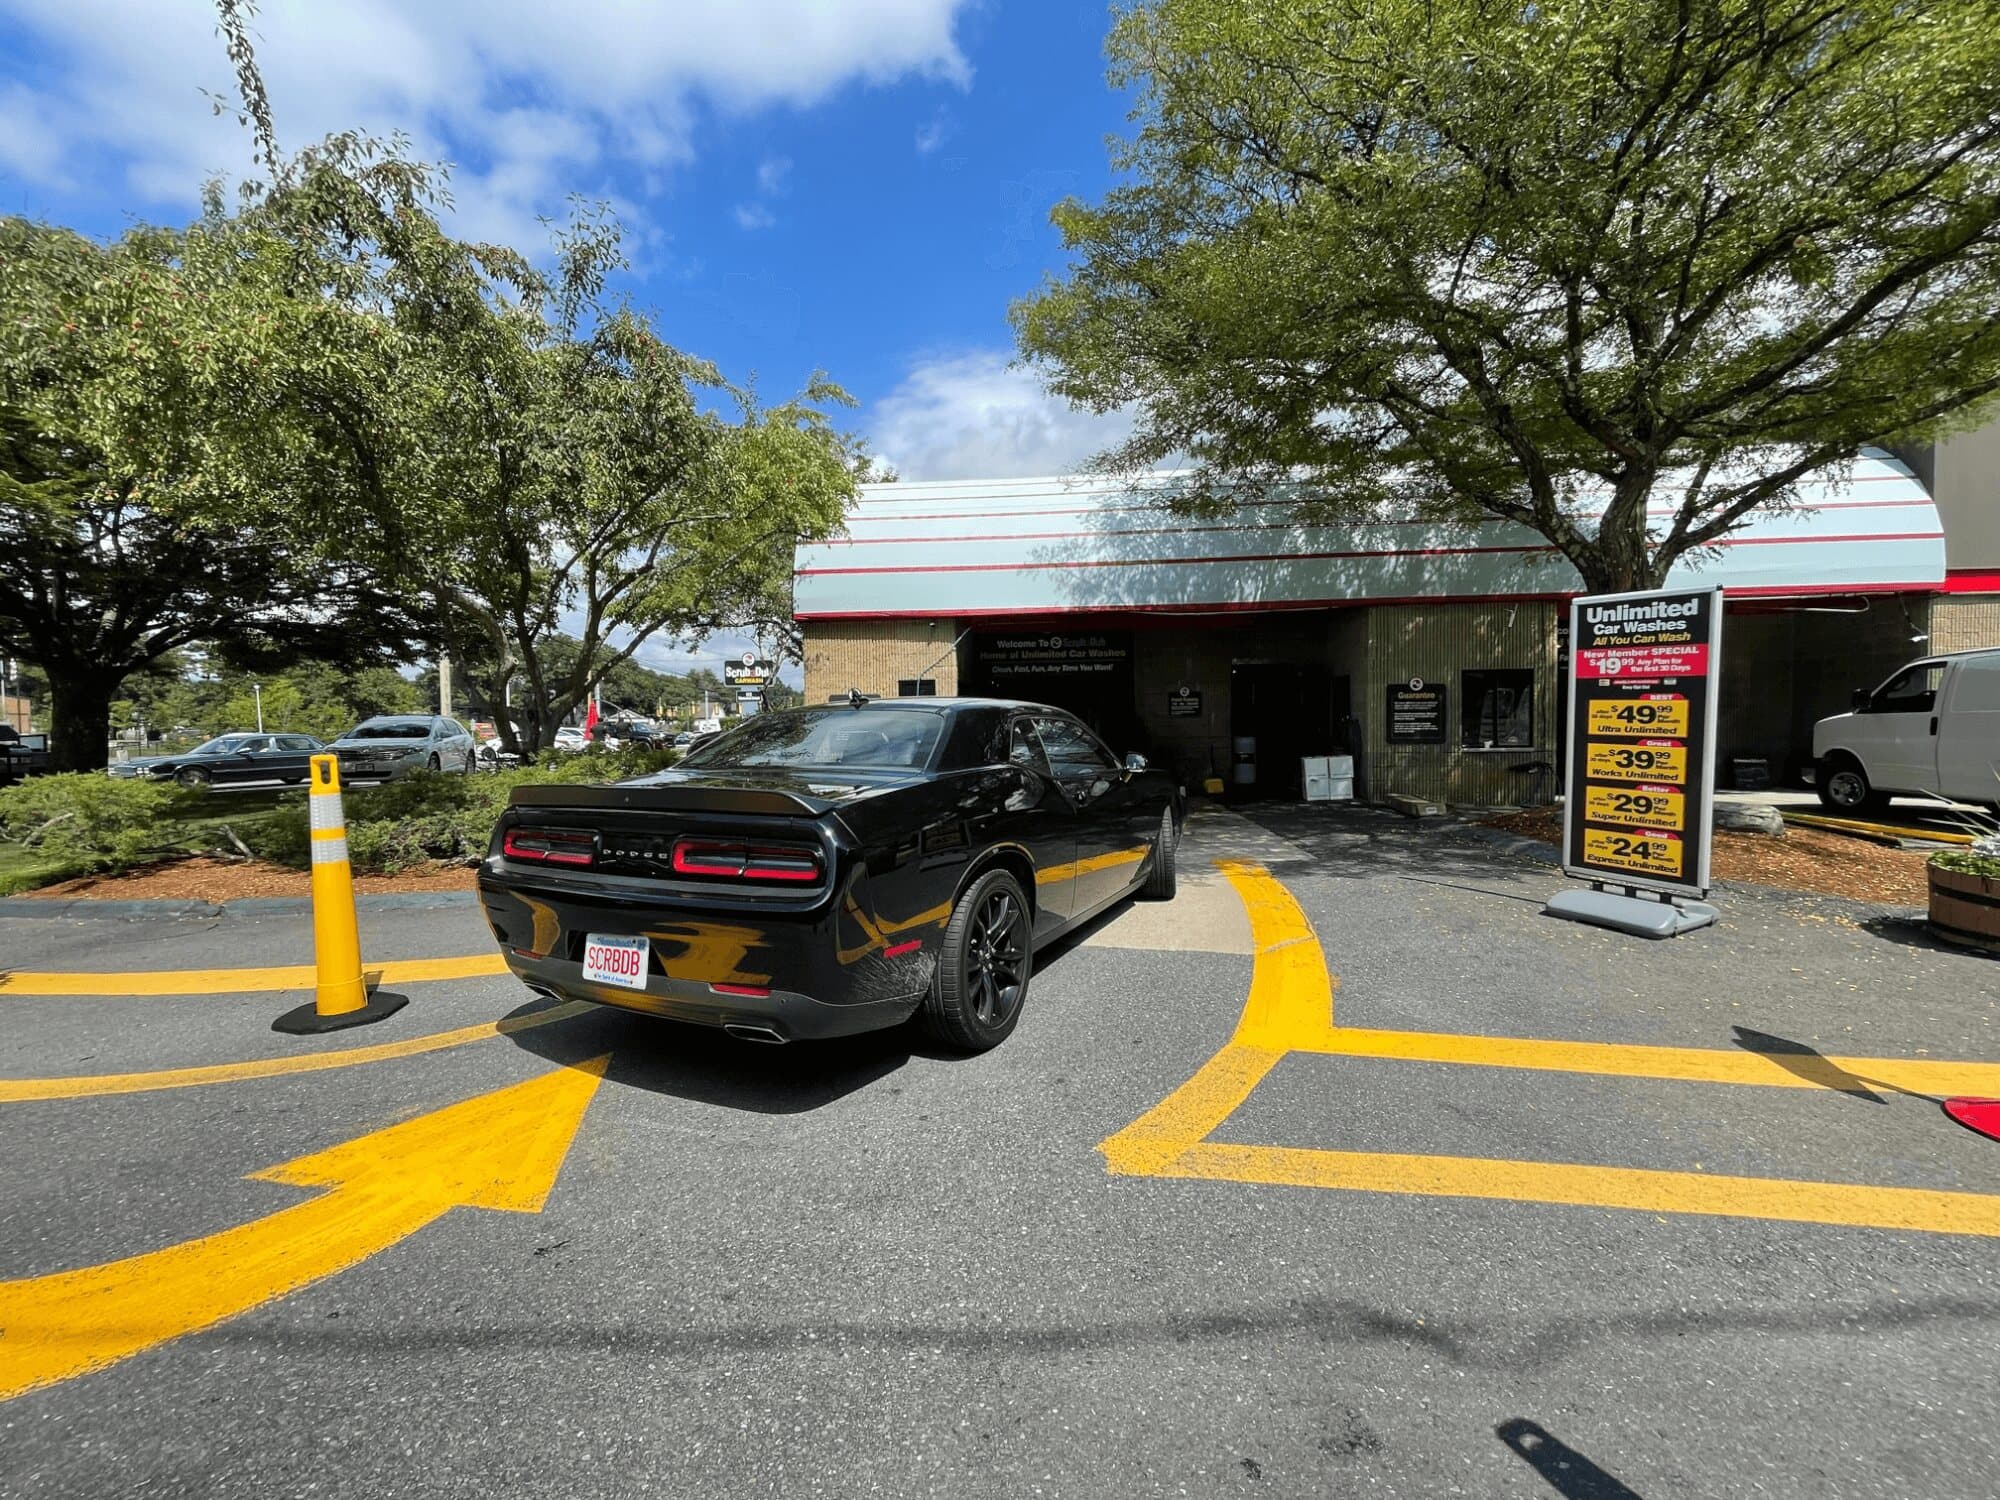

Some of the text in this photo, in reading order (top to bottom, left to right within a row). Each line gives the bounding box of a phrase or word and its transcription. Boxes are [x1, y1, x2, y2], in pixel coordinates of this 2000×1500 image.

[1586, 598, 1698, 622] Unlimited
[1594, 620, 1687, 635] Car Washes
[997, 640, 1036, 648] Welcome
[1593, 632, 1691, 646] All You Can Wash
[1022, 650, 1066, 658] Unlimited
[1070, 650, 1086, 658] Car
[1089, 648, 1126, 658] Washes
[1608, 648, 1648, 658] Member
[1651, 646, 1699, 656] SPECIAL
[726, 666, 750, 678] Scrub
[1624, 726, 1677, 734] Unlimited
[1592, 768, 1678, 780] Works Unlimited
[1592, 812, 1676, 827] Super Unlimited
[603, 848, 668, 859] DODGE
[1587, 854, 1678, 874] Express Unlimited
[588, 946, 640, 976] SCRBDB
